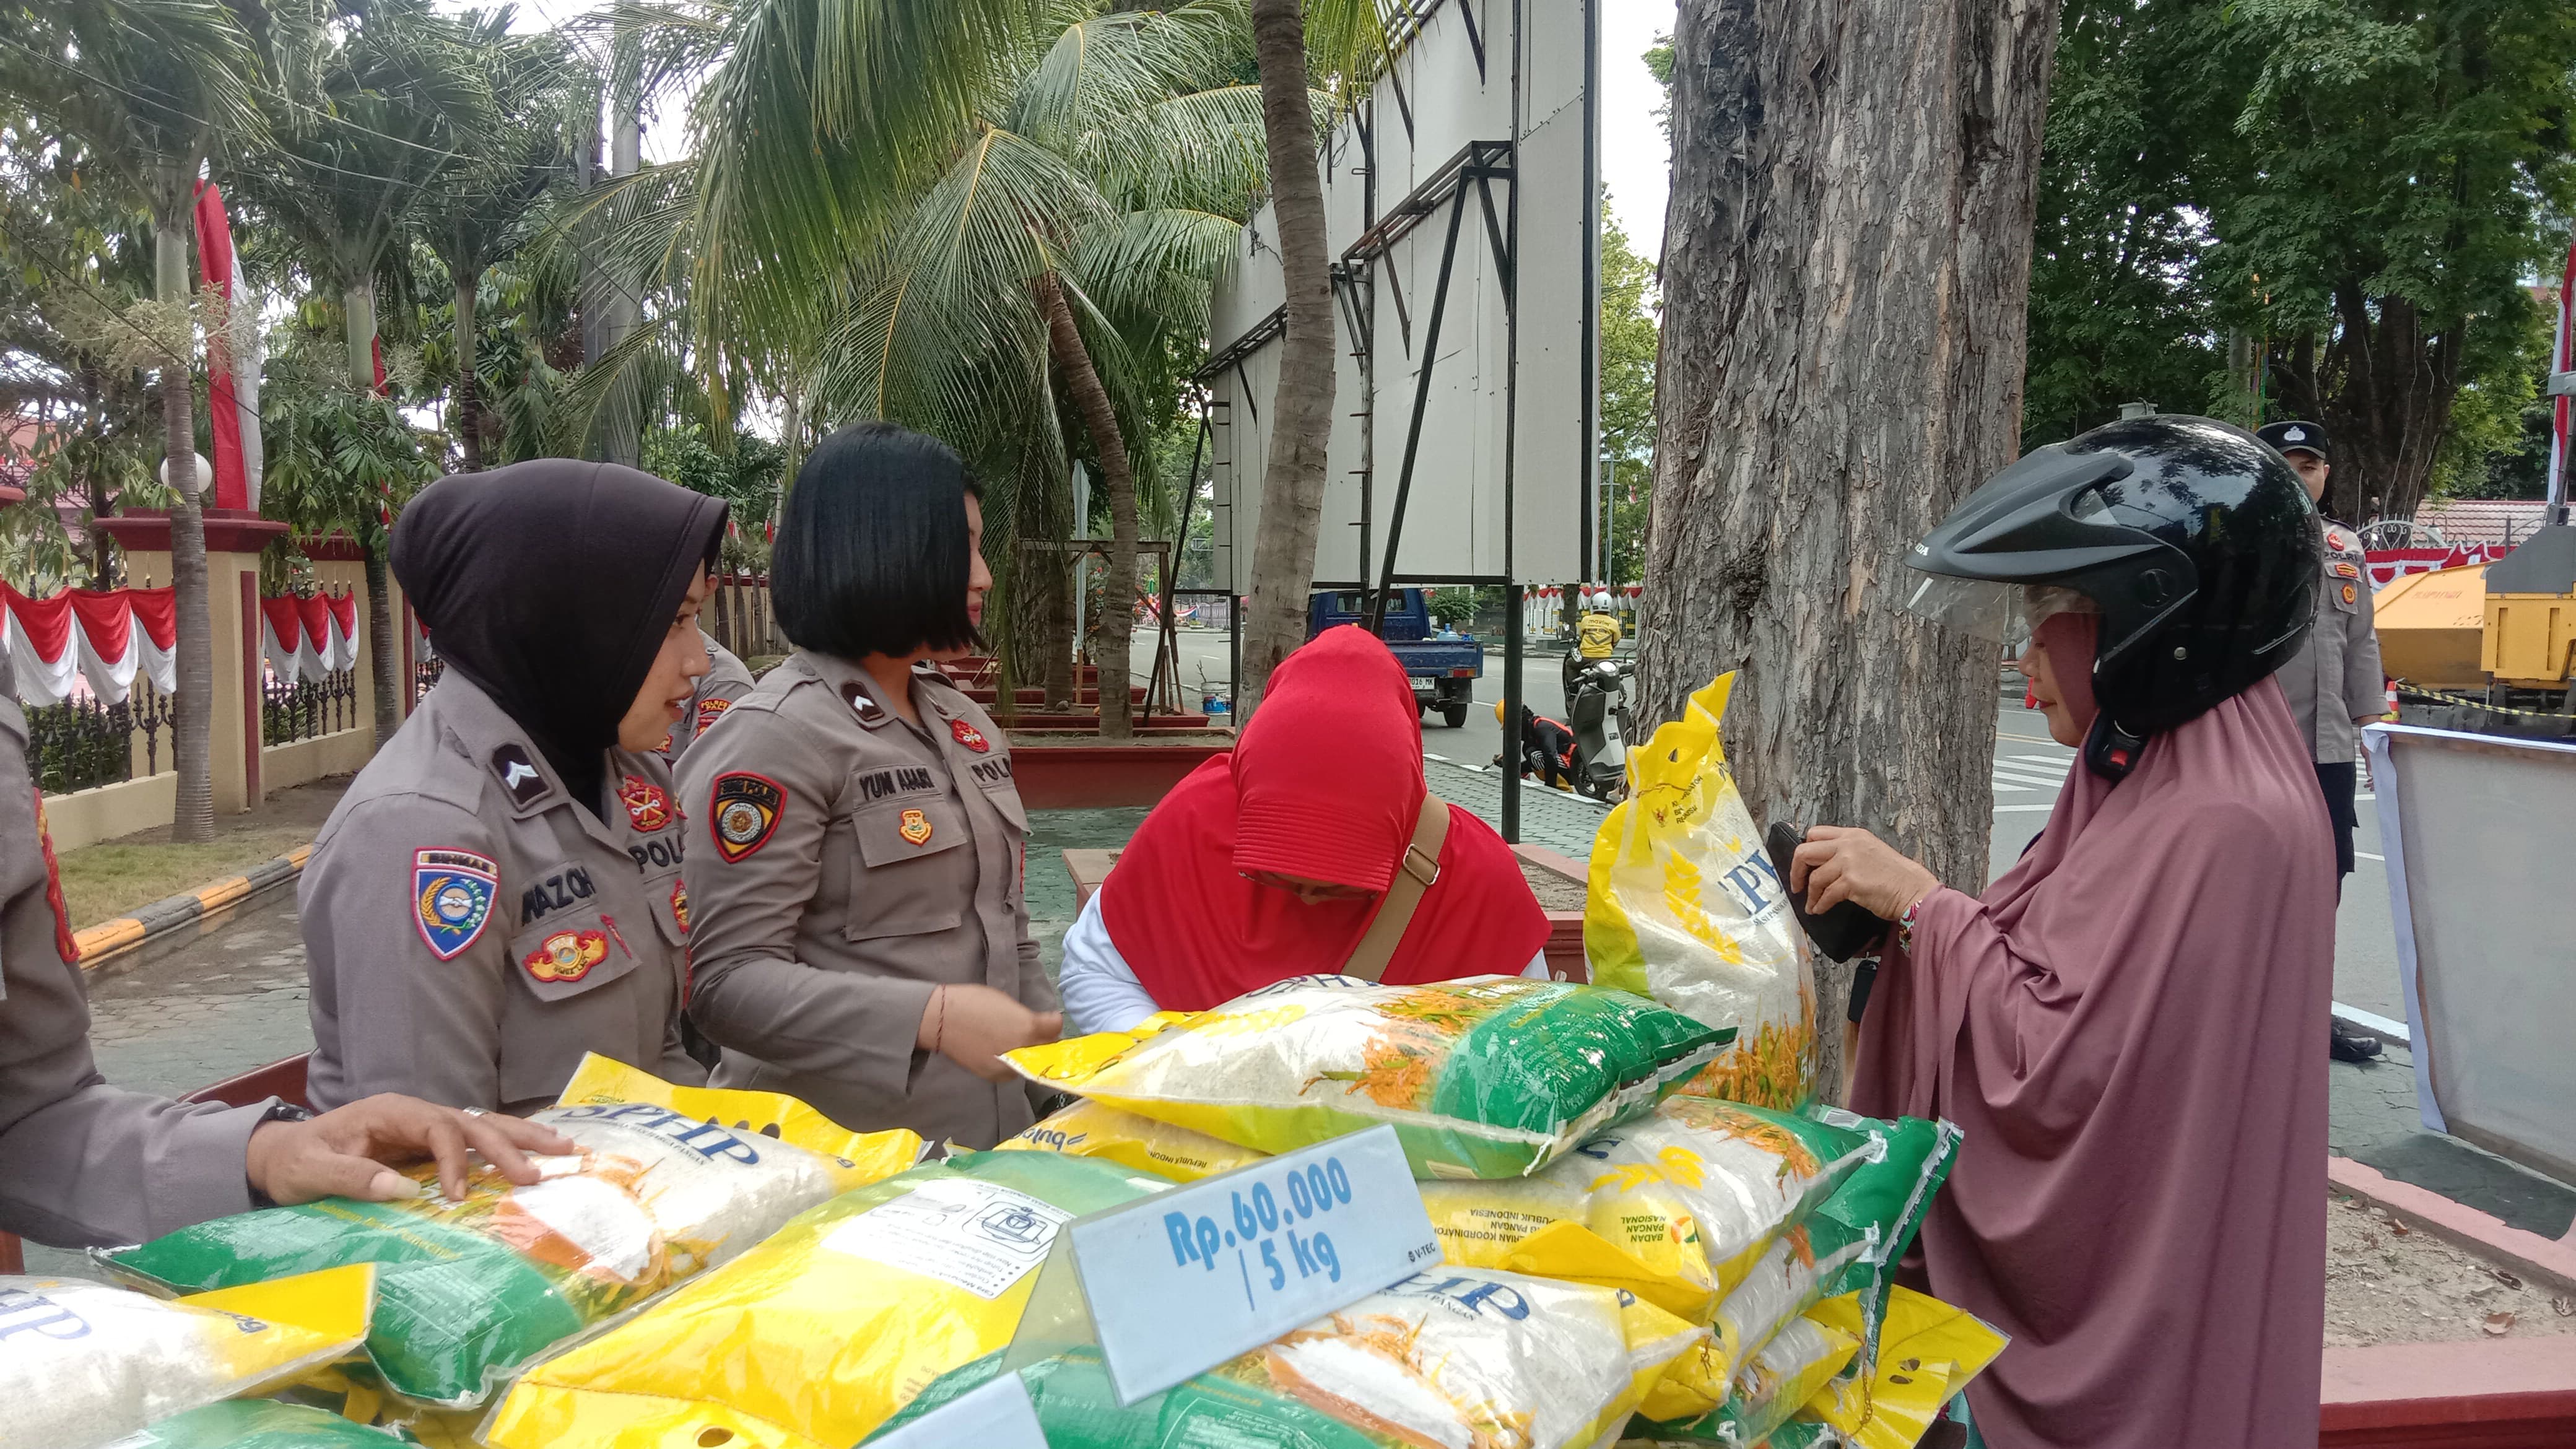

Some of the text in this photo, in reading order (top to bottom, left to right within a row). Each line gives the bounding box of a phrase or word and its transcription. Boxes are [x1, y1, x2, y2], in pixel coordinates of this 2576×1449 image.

[1163, 1156, 1352, 1272] Rp.60.000
[1470, 1208, 1519, 1221] INDONESIA
[1620, 1214, 1667, 1225] NASIONAL
[1490, 1221, 1528, 1233] PANGAN
[1625, 1223, 1664, 1234] PANGAN
[1630, 1233, 1664, 1243] BADAN
[1286, 1229, 1341, 1284] kg
